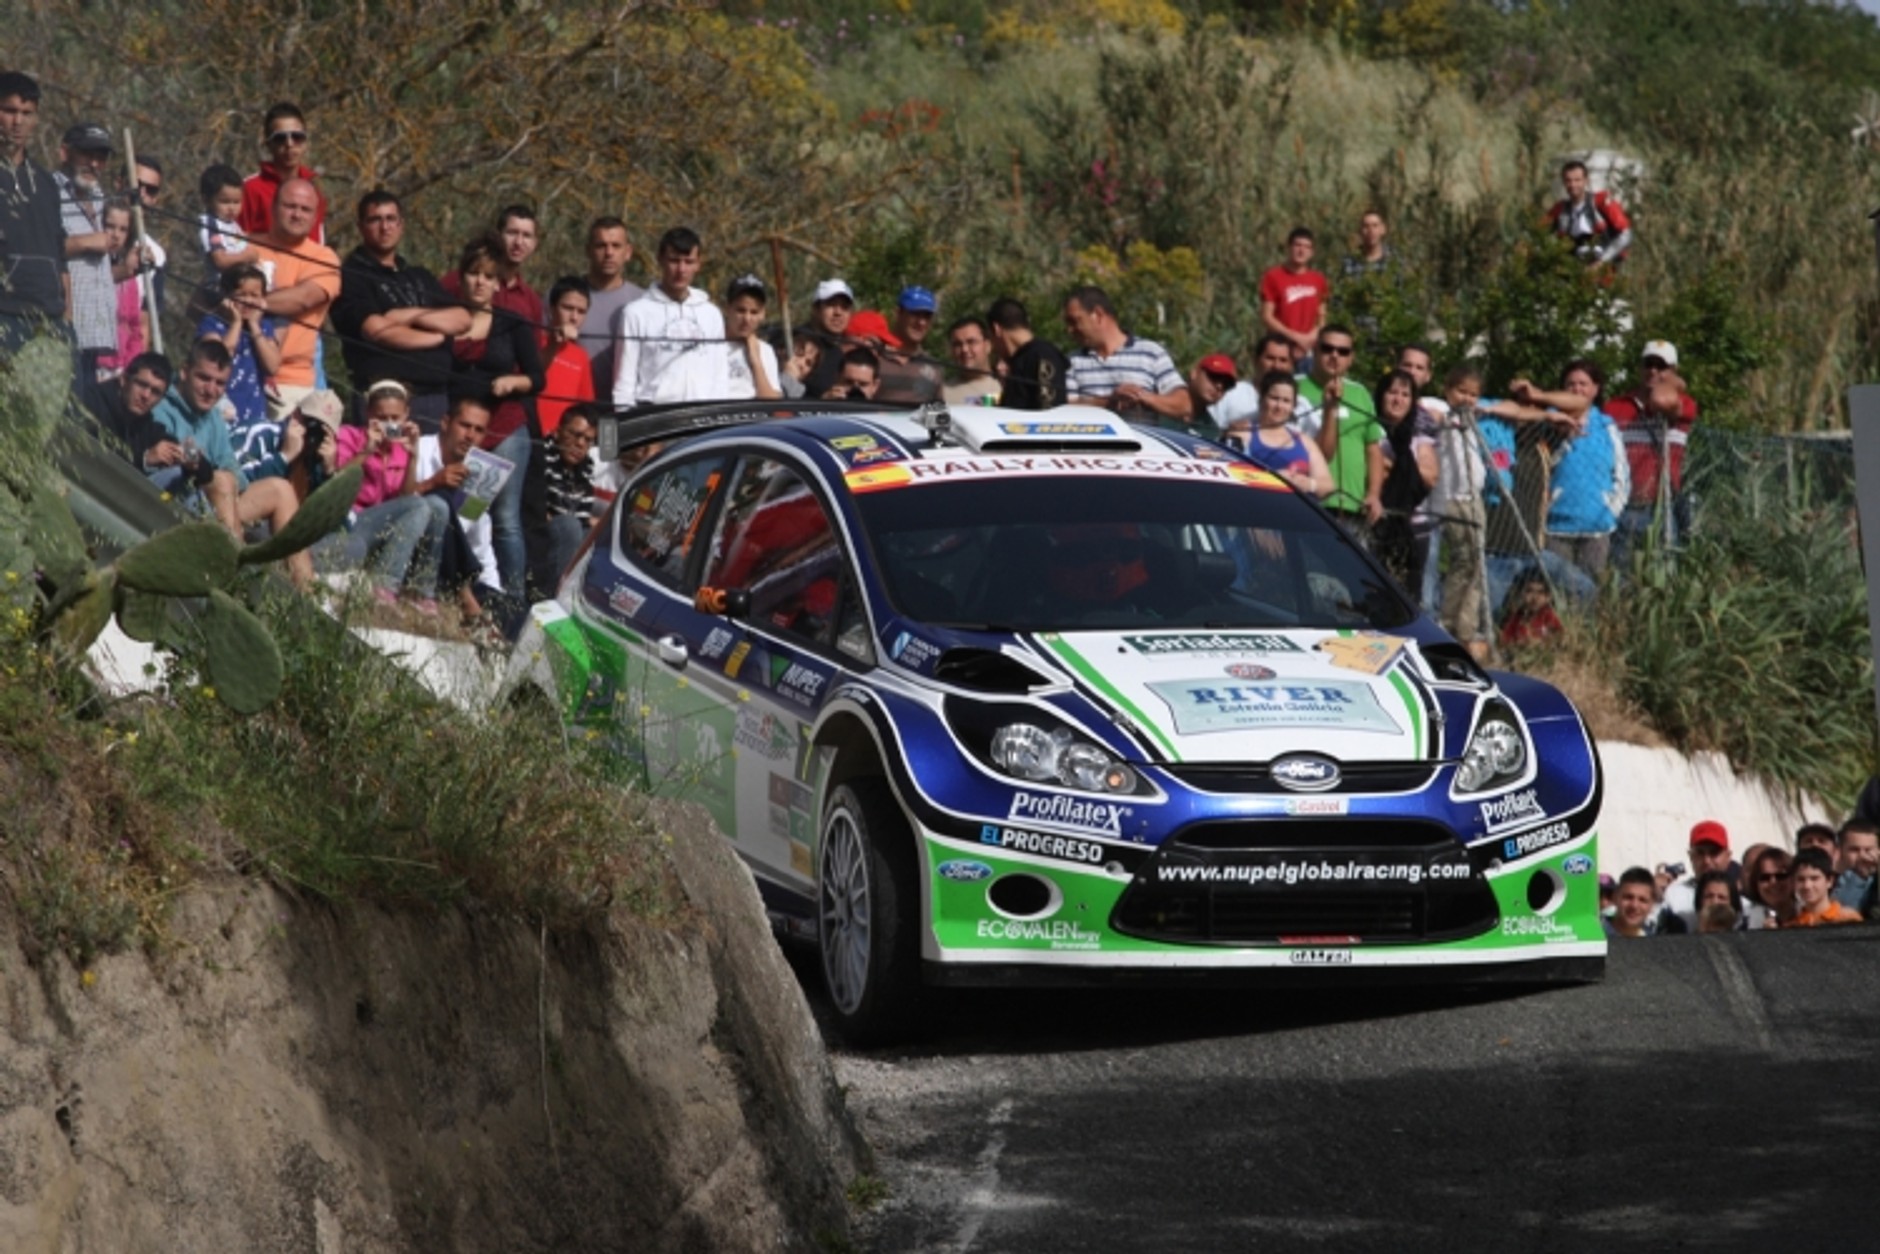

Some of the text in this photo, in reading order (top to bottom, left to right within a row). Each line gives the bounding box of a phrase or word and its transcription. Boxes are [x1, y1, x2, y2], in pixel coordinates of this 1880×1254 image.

[909, 457, 1231, 479] RALLY-IRC.COM
[1186, 686, 1353, 704] RIVER
[1218, 702, 1345, 713] Estrella Galicia
[1272, 760, 1325, 779] Ford
[944, 862, 986, 880] Ford
[1157, 861, 1471, 884] www.nupelglobalracing.com
[1566, 857, 1590, 874] Ford
